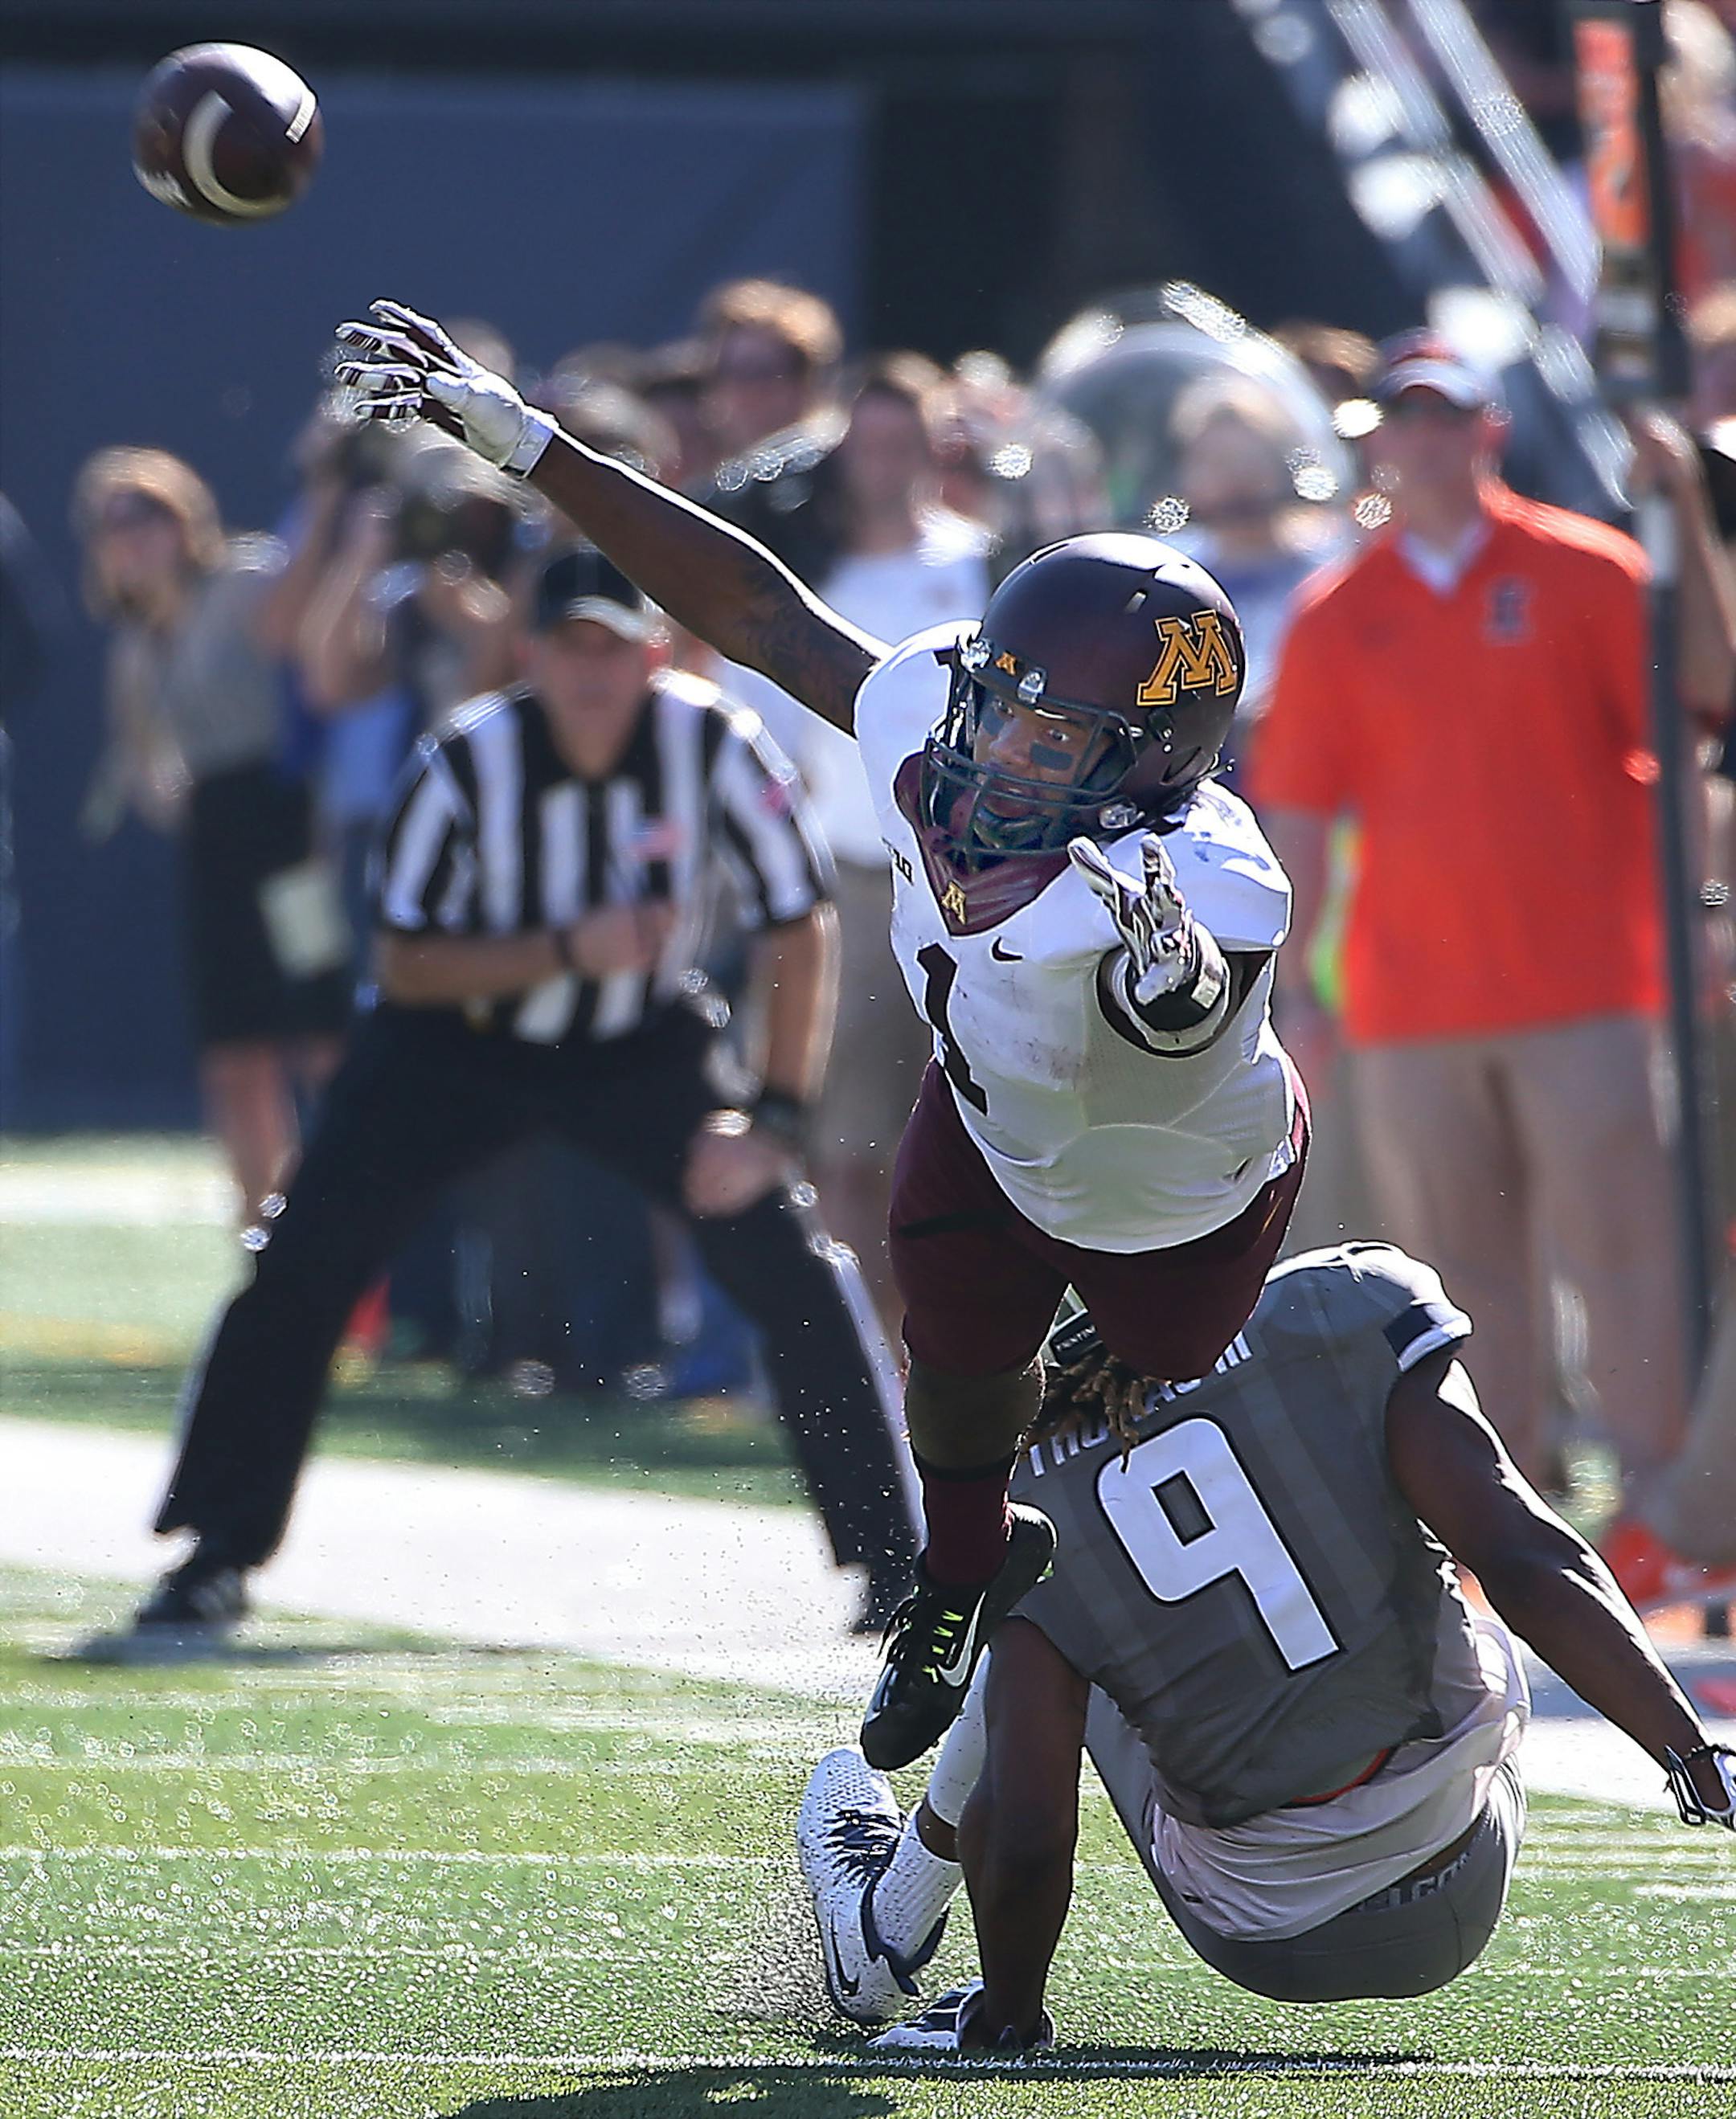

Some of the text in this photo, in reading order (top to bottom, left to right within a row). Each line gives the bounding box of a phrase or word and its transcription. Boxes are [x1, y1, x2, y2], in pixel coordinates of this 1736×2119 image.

[1136, 609, 1237, 706] M
[916, 942, 989, 1117] 1
[1096, 1417, 1341, 1671] 9
